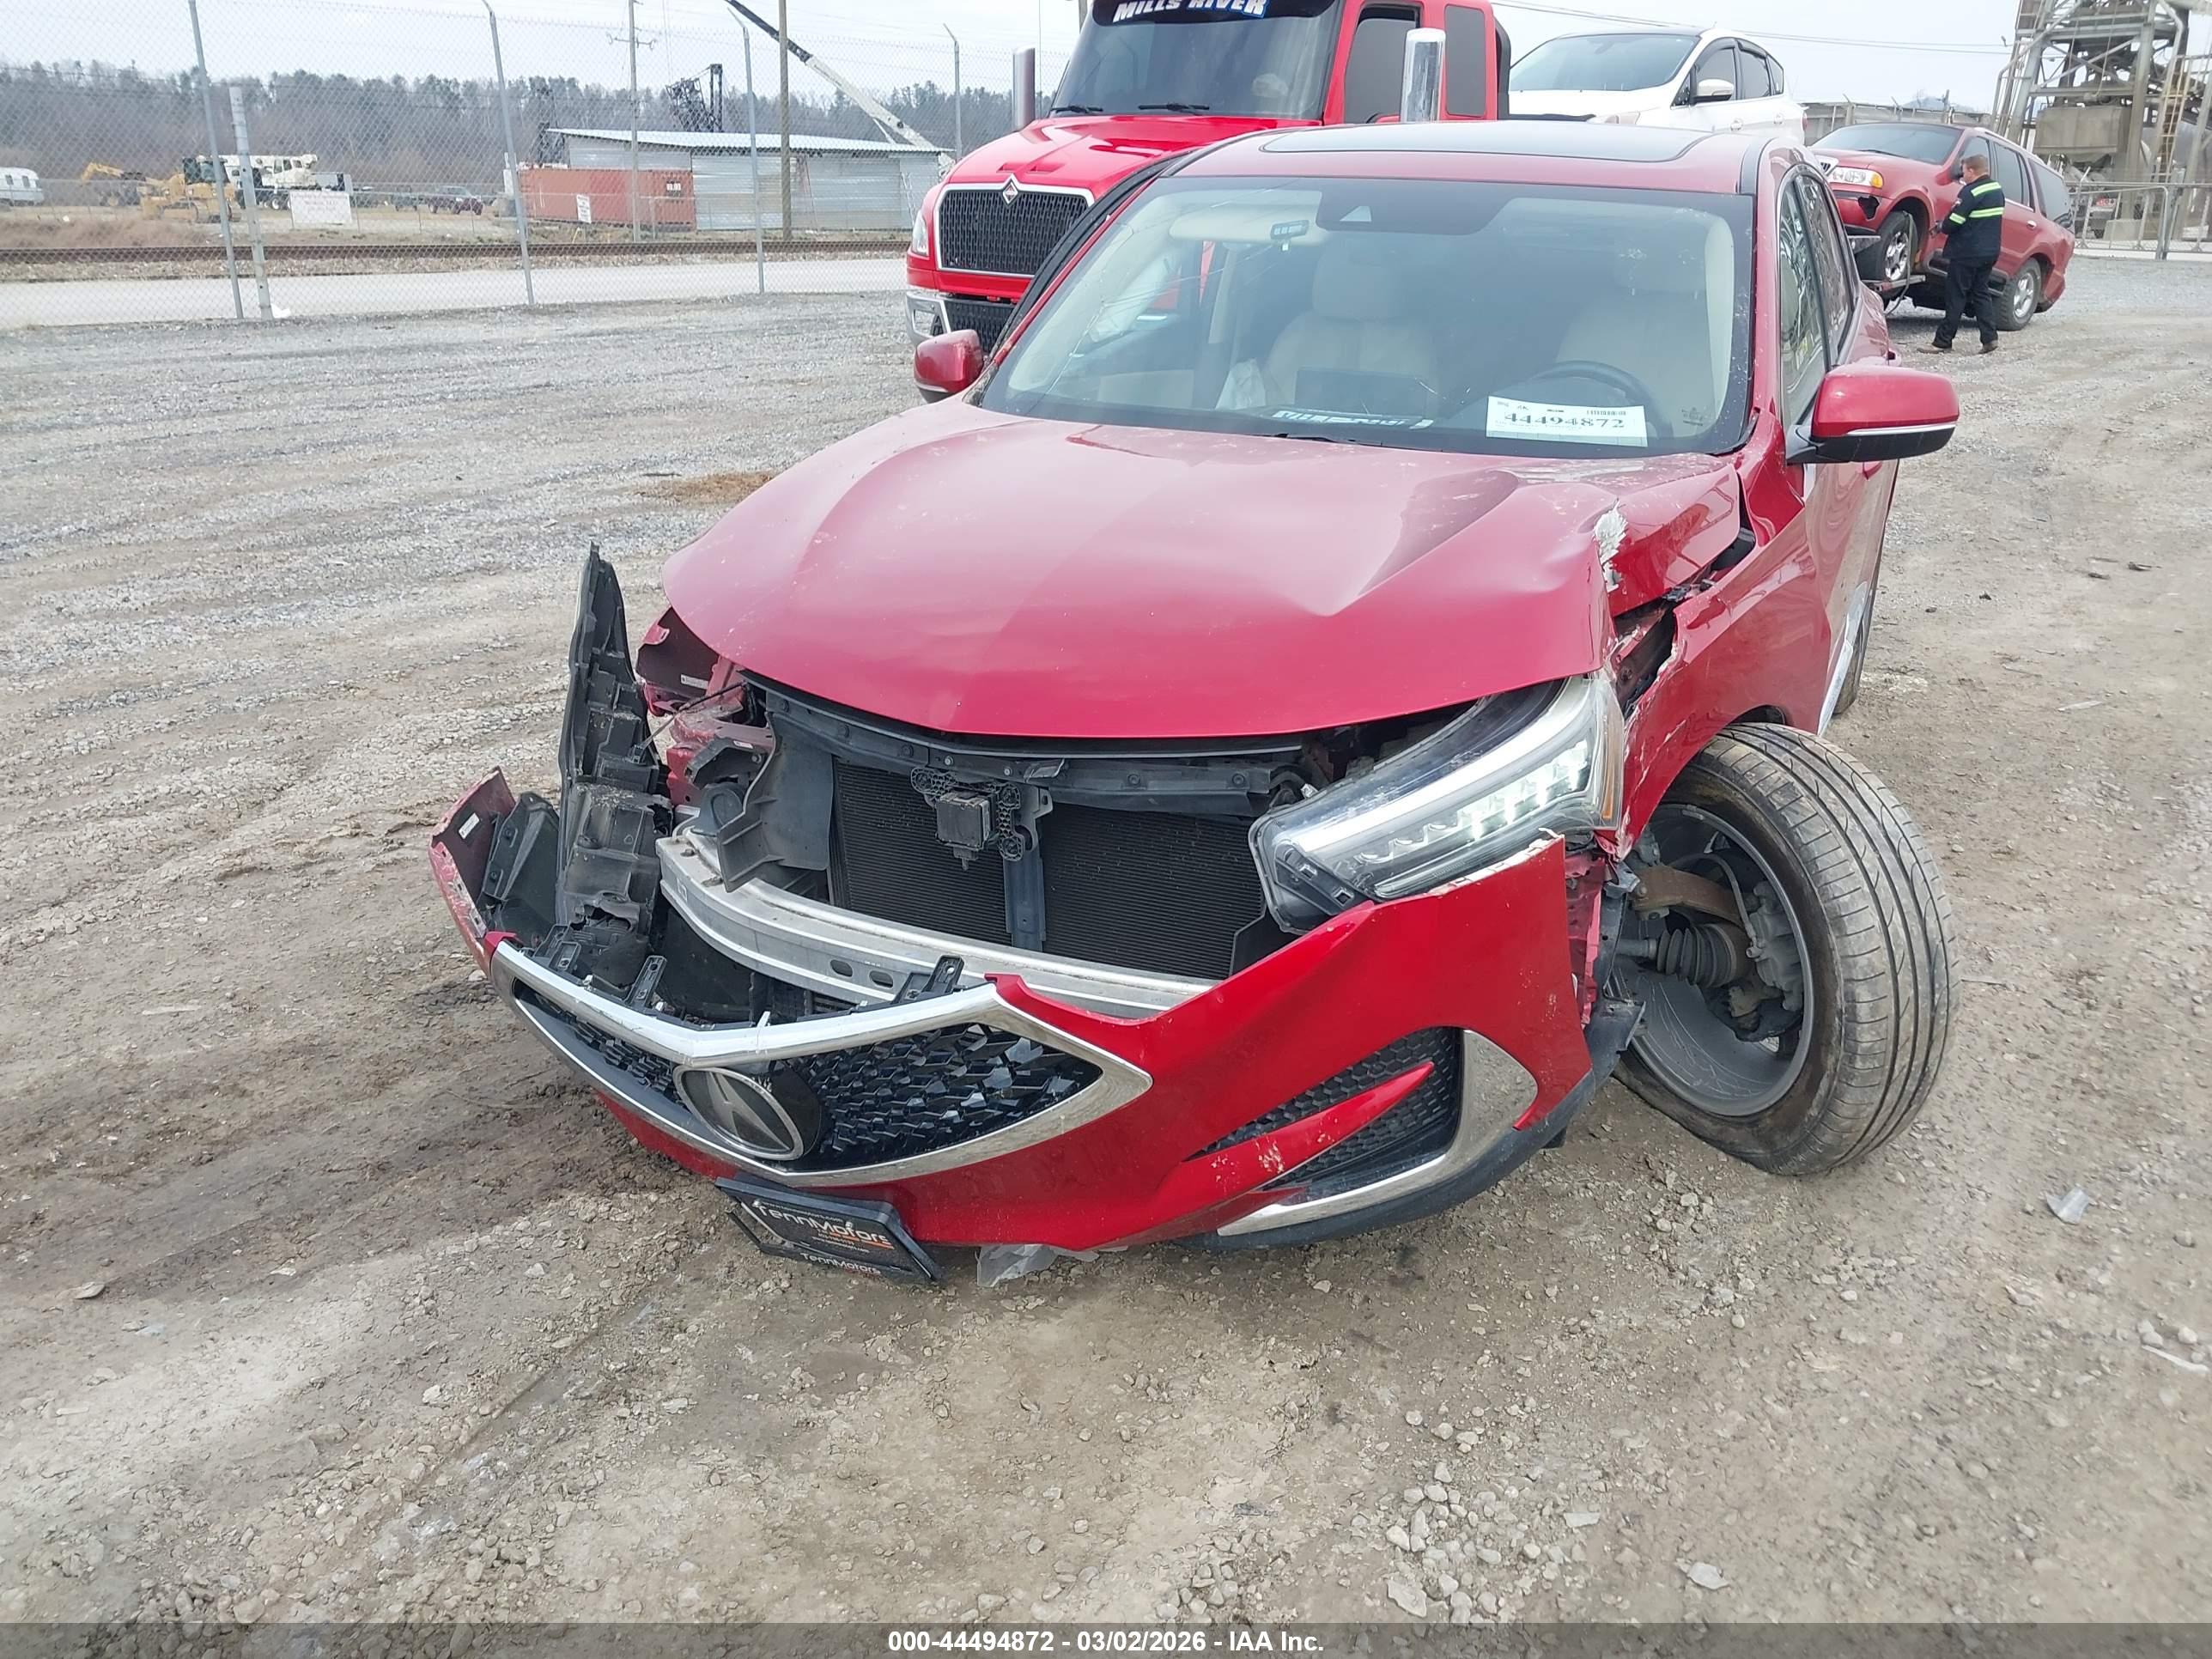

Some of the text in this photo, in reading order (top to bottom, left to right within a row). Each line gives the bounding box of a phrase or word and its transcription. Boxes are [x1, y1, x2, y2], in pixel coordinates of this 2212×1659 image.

[1111, 0, 1182, 23] MILLS
[1504, 412, 1626, 428] 44494872
[755, 1204, 892, 1246] TennMotors
[799, 1252, 882, 1275] TennMotors
